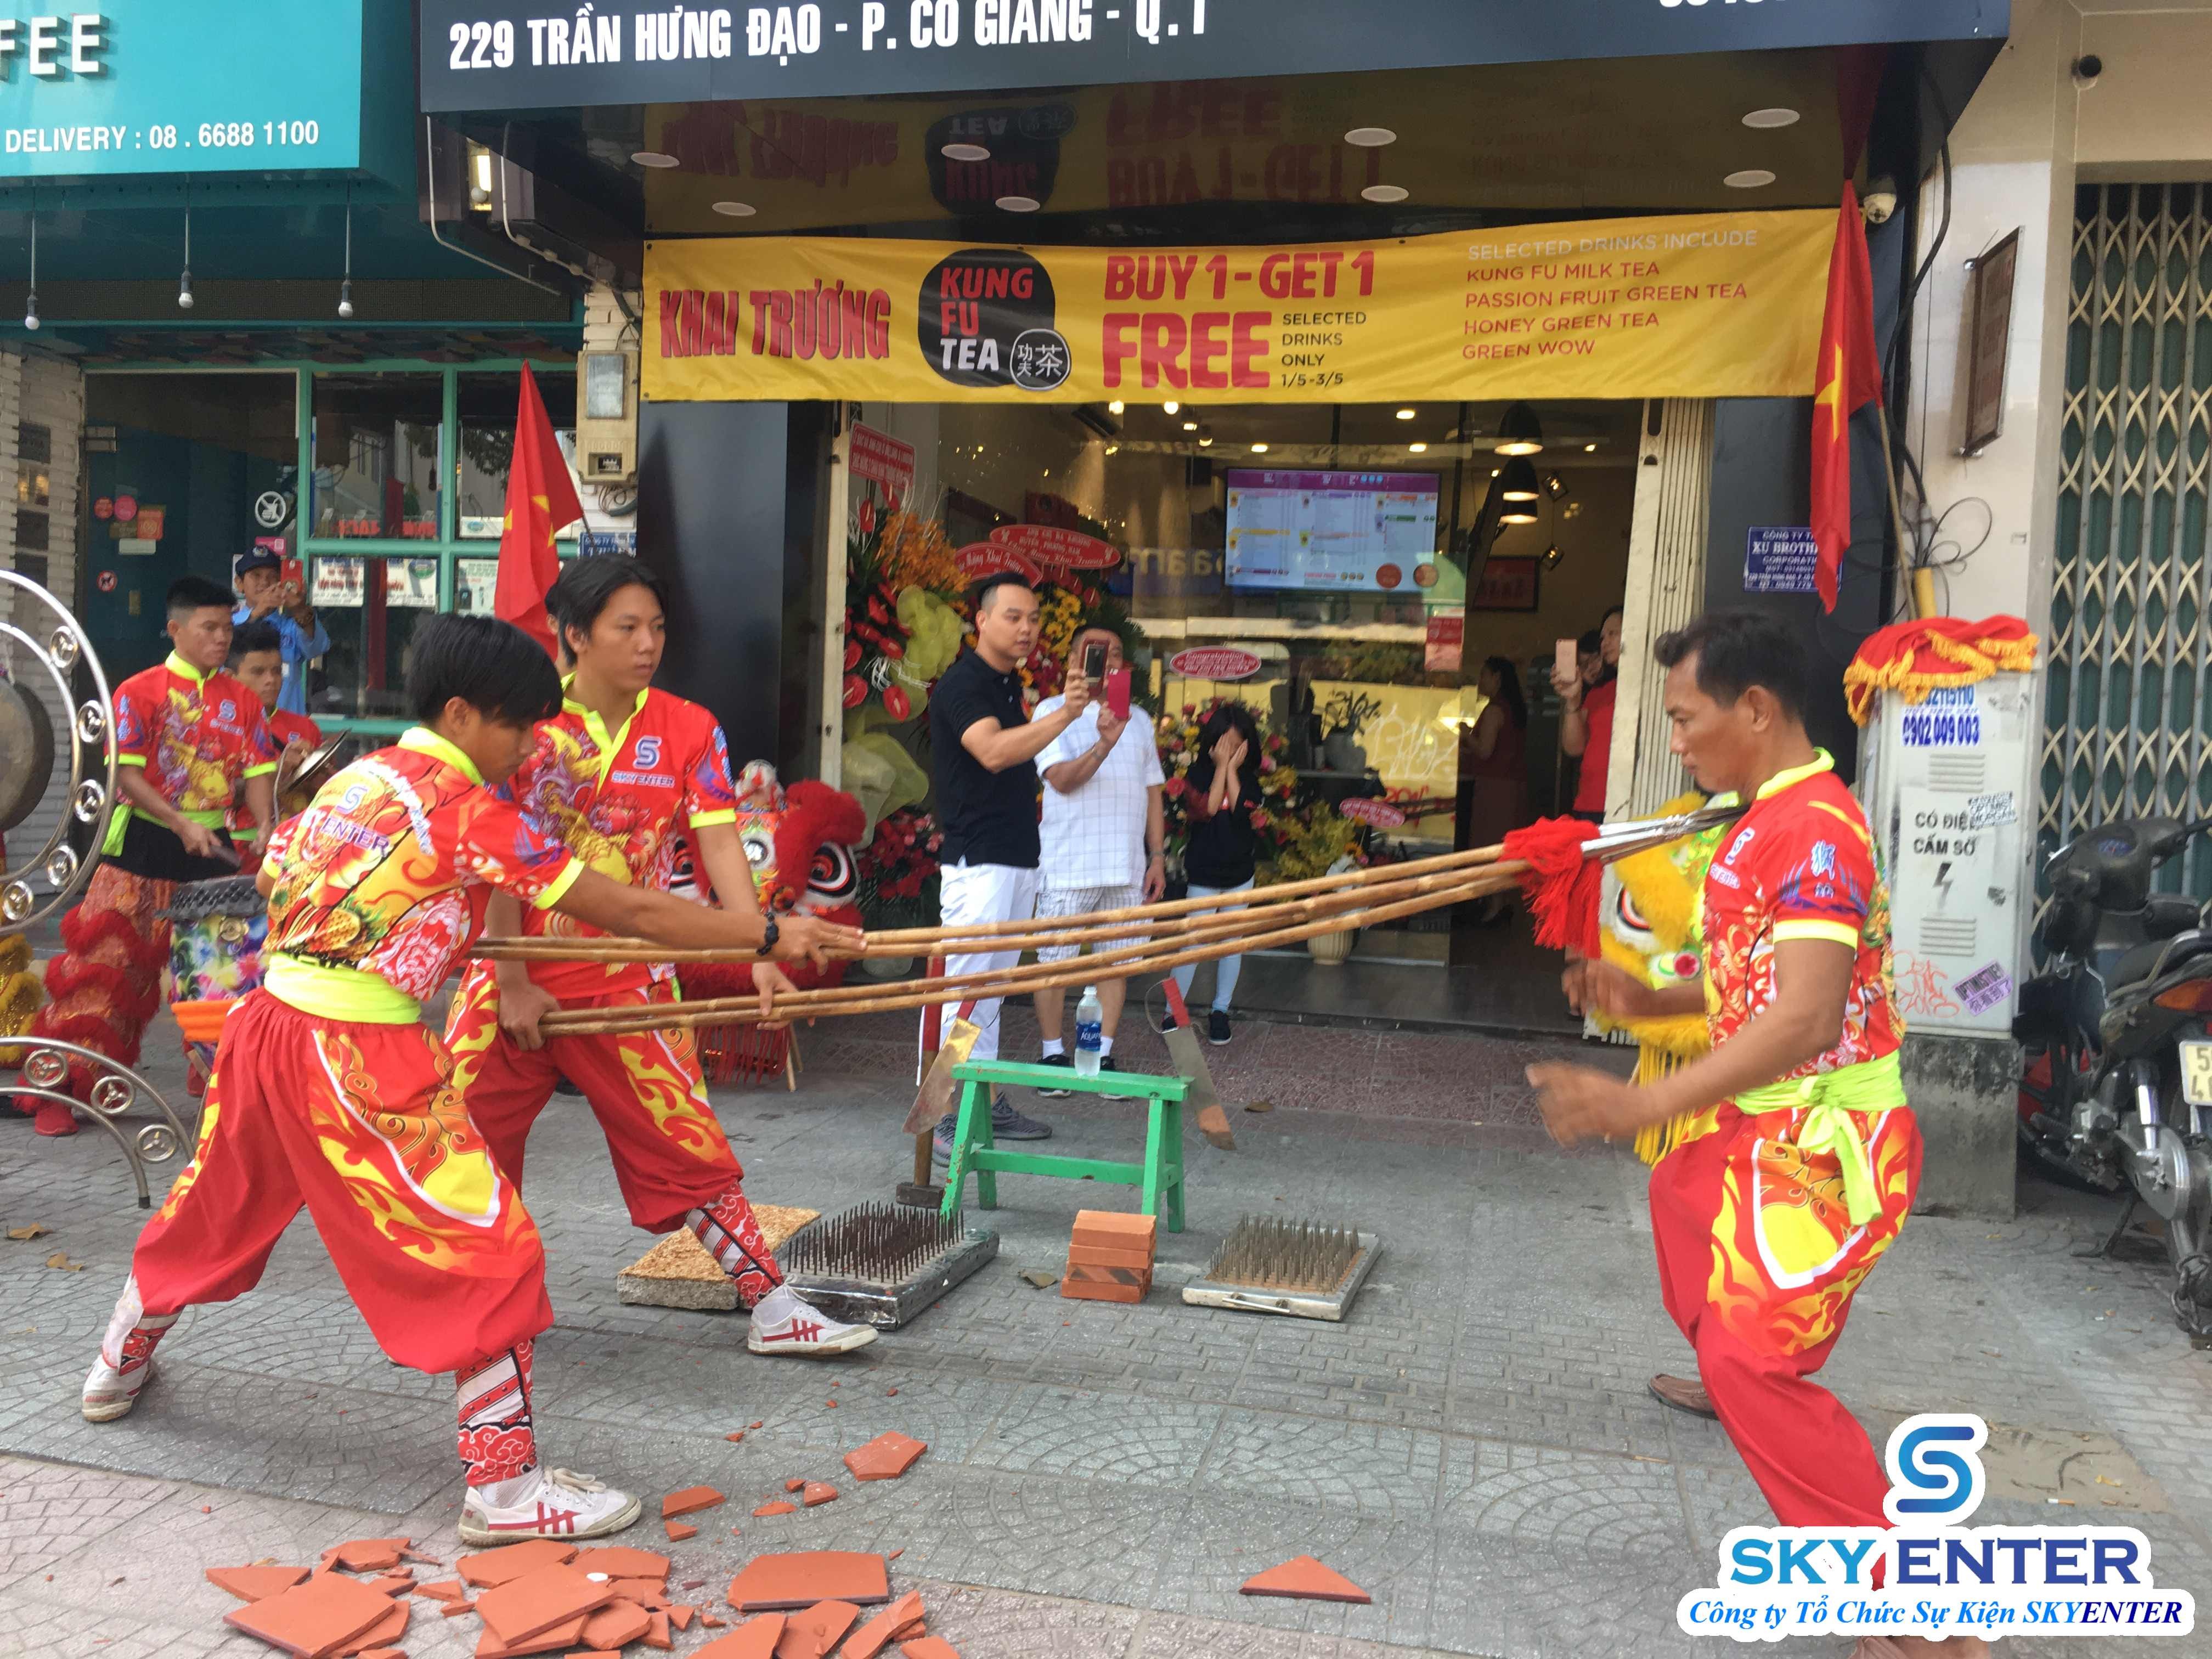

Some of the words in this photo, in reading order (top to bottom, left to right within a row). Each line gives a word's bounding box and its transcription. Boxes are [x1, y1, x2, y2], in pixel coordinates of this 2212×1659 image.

[450, 20, 514, 70] 229
[527, 3, 620, 65] TRẦN
[635, 5, 731, 61] HƯNG
[746, 4, 820, 66] ĐẠO
[862, 2, 896, 50] P.
[974, 0, 1092, 45] GIANG
[6, 126, 126, 153] DELIVERY
[149, 125, 177, 149] 08
[199, 122, 255, 147] 6688
[263, 120, 319, 144] 1100
[1469, 241, 1572, 261] SELECTED
[1580, 235, 1656, 252] DRINKS
[1664, 229, 1757, 249] INCLUDE
[940, 267, 1033, 299] KUNG
[1104, 255, 1198, 301] BUY
[1467, 267, 1524, 281] KUNG
[1531, 264, 1557, 280] FU
[1565, 263, 1612, 280] MILK
[1620, 262, 1660, 277] TEA
[1466, 291, 1552, 308] PASSION
[1560, 289, 1619, 306] FRUIT
[1627, 285, 1698, 301] GREEN
[1706, 283, 1747, 298] TEA
[660, 290, 738, 358] KHAI
[749, 278, 890, 359] TRƯƠNG
[940, 302, 979, 336] FU
[1283, 312, 1367, 325] SELECTED
[1464, 318, 1535, 334] HONEY
[1542, 314, 1611, 332] GREEN
[1620, 313, 1660, 327] TEA
[1103, 311, 1272, 389] FREE
[1282, 333, 1342, 346] DRINKS
[1462, 344, 1530, 359] GREEN
[1538, 340, 1595, 356] WOW
[940, 338, 999, 371] TEA
[1281, 354, 1325, 366] ONLY
[1752, 541, 1770, 555] XU
[1915, 808, 1938, 829] CÓ
[320, 816, 391, 857] ENTER
[1914, 833, 1948, 855] CẤM
